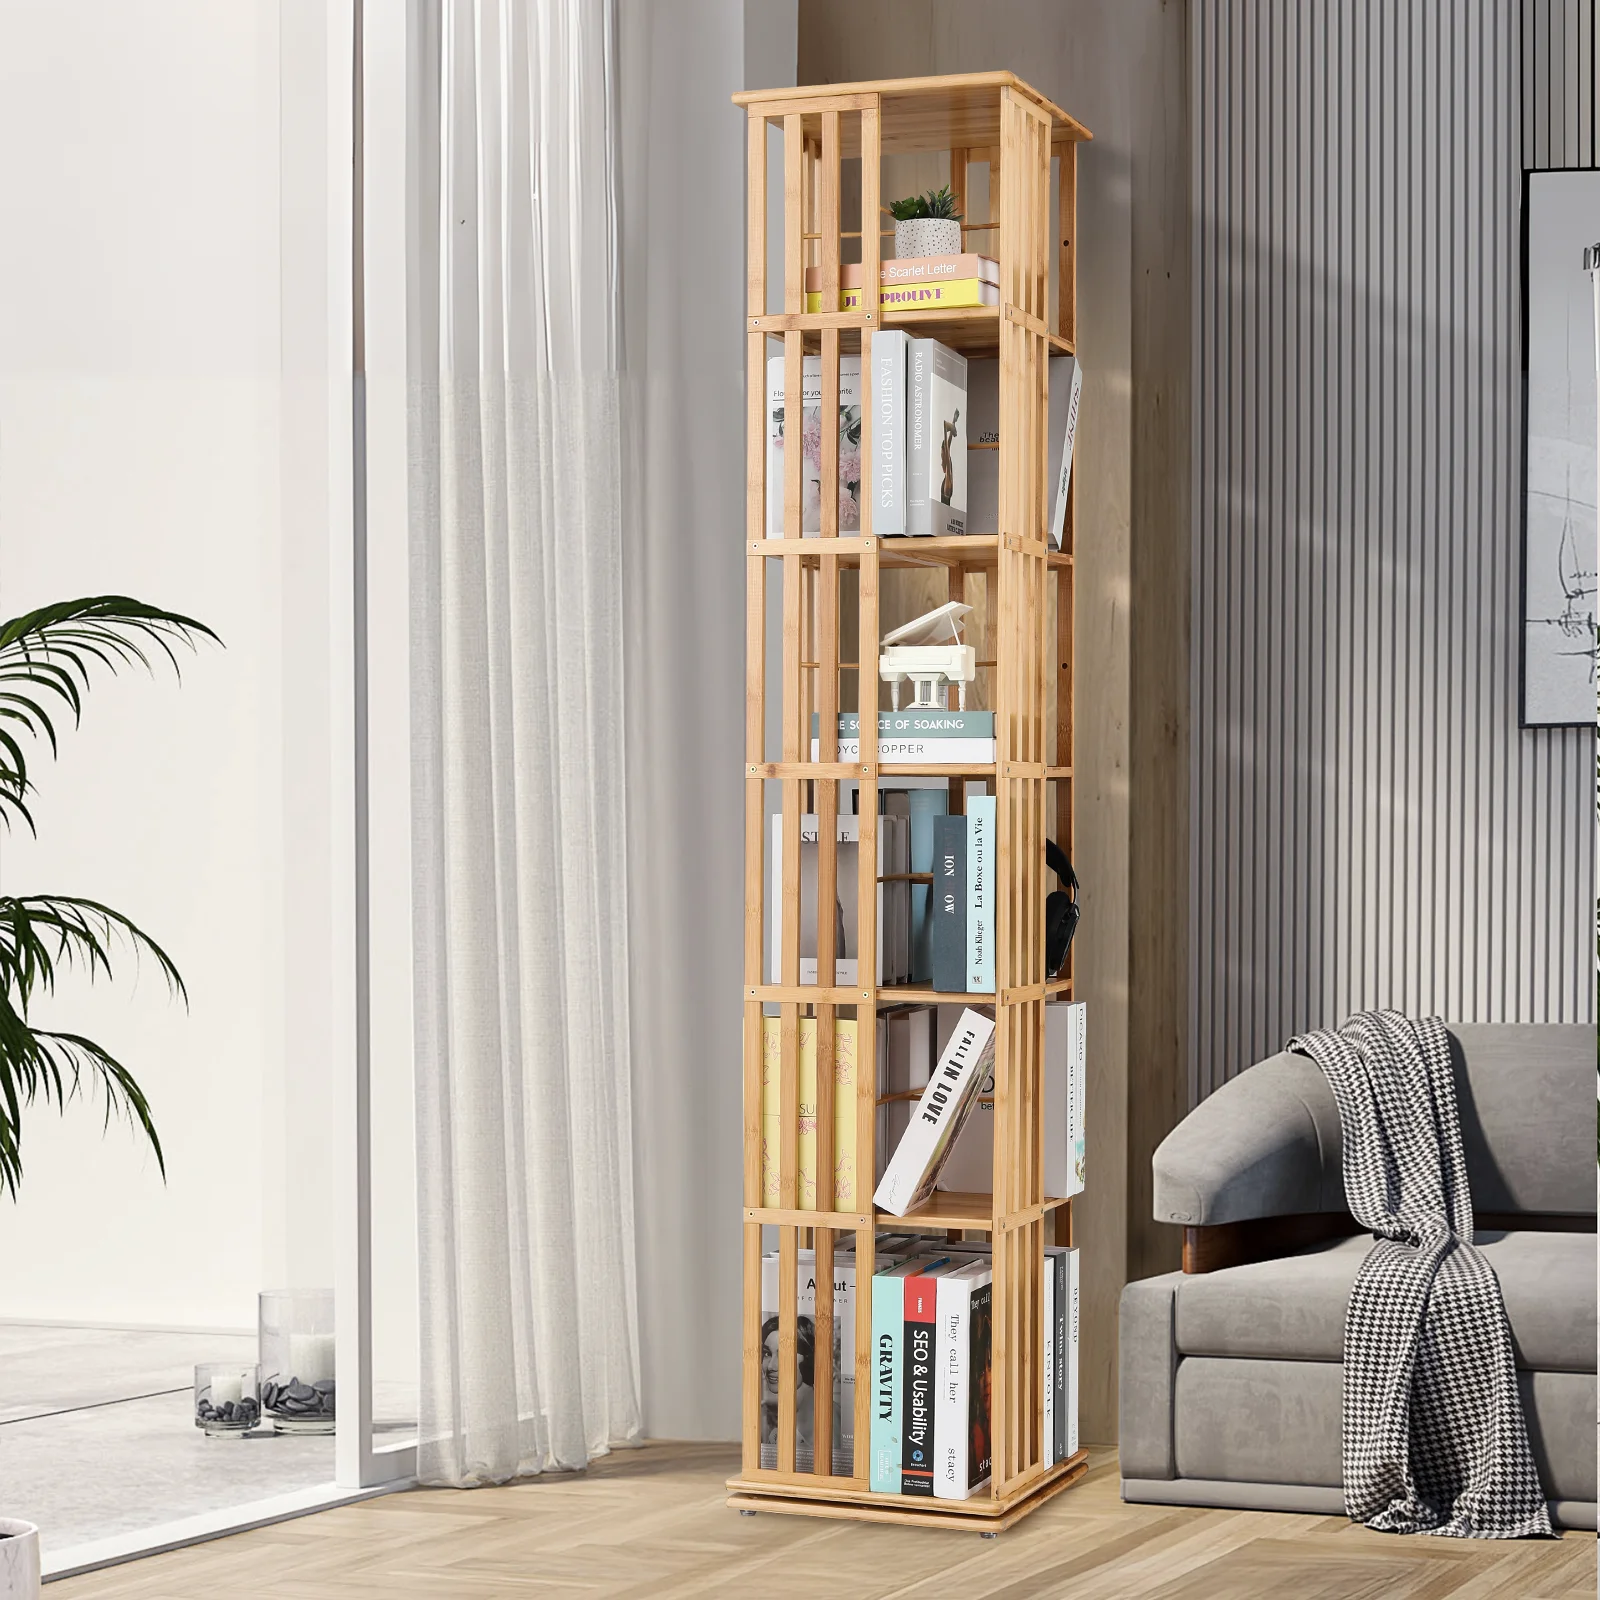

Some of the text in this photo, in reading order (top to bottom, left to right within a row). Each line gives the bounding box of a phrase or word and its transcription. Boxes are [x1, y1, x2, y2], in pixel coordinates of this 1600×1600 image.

[889, 265, 925, 278] Scarlet
[927, 263, 957, 275] Letter
[881, 358, 893, 508] FASHION TOP PICKS
[914, 352, 923, 450] RADIO ASTRONOMER
[878, 744, 924, 754] OPPER
[895, 720, 910, 730] OF
[914, 719, 965, 730] SOAKING
[975, 817, 985, 965] Noah Klieger La Boxe ou la Vie
[922, 1030, 976, 1125] FALL IN LOVE
[879, 1334, 893, 1423] GRAVITY
[913, 1330, 929, 1362] SEO
[913, 1365, 928, 1377] &
[908, 1380, 928, 1446] Usability
[946, 1314, 960, 1483] They call her stacy
[979, 1456, 992, 1472] stac
